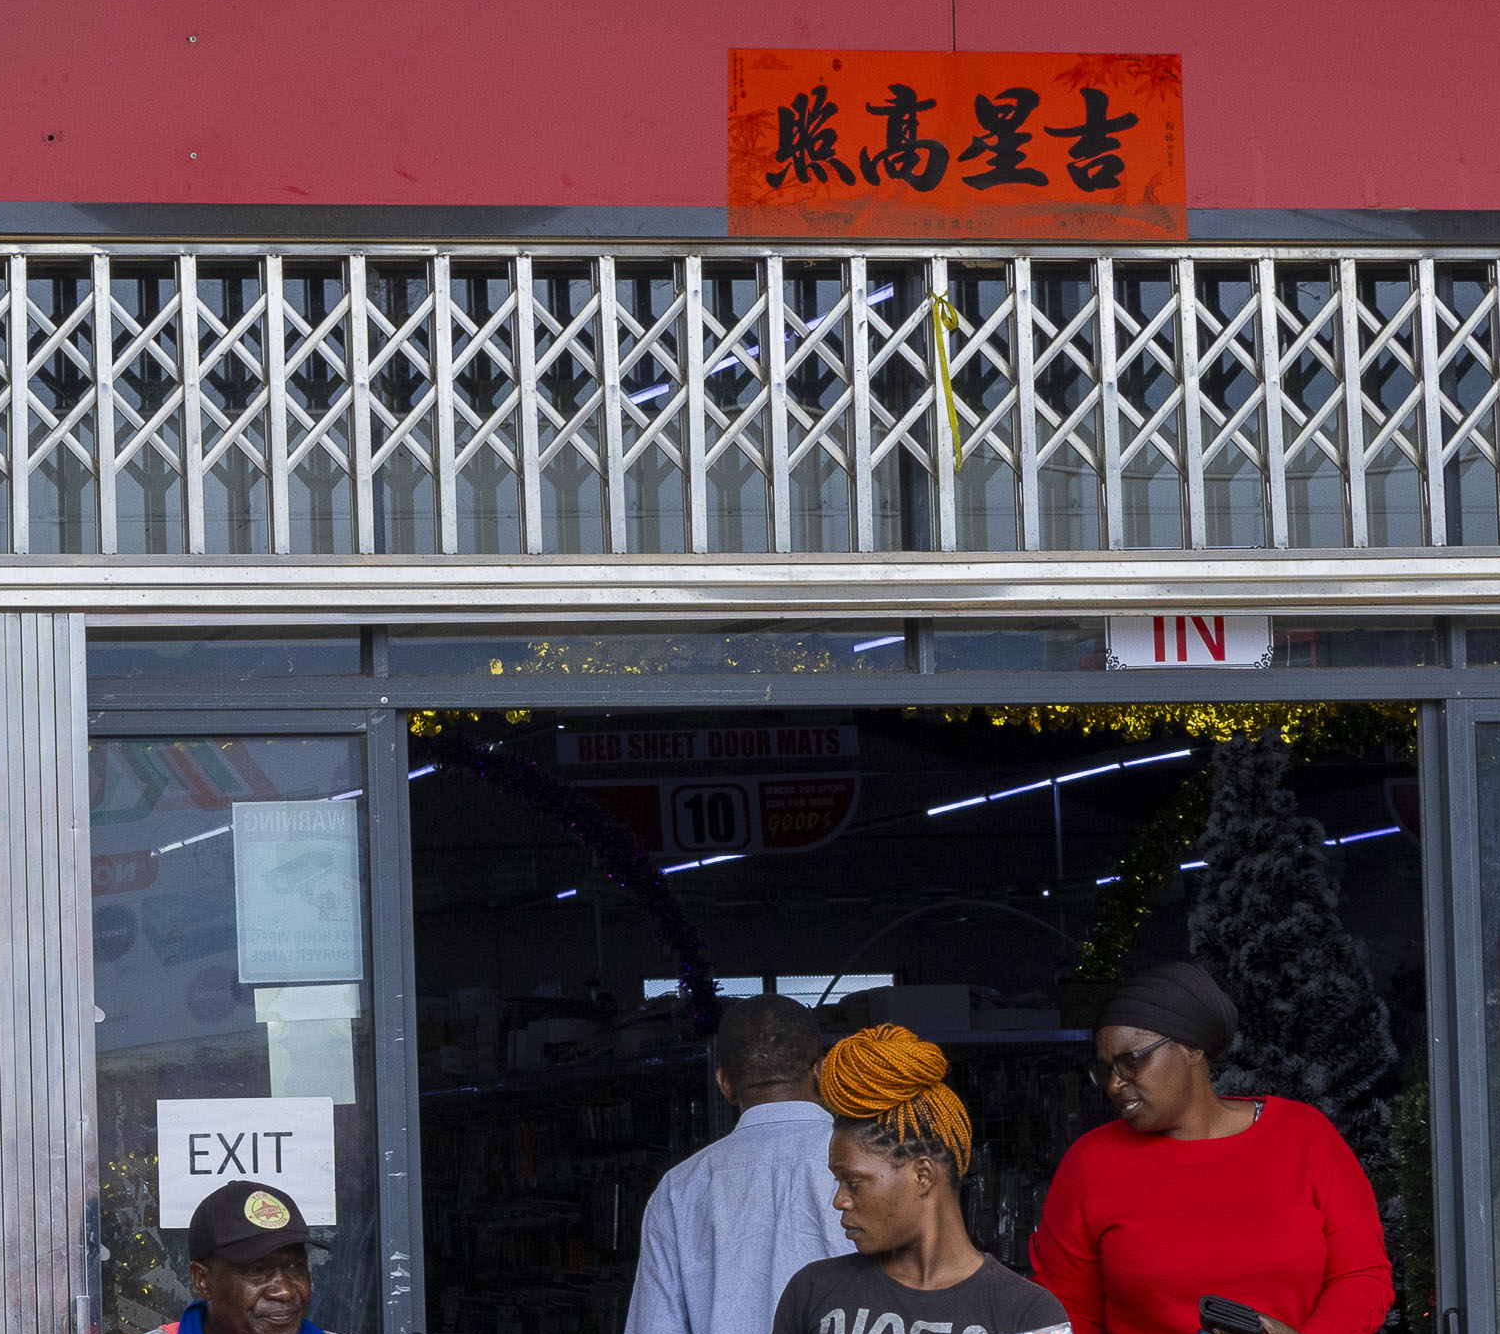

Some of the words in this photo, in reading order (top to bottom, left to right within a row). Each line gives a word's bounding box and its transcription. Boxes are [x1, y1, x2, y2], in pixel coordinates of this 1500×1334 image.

[1153, 615, 1226, 662] IN
[577, 733, 623, 761] BED
[628, 731, 697, 760] SHEET
[708, 729, 772, 758] DOOR
[777, 727, 841, 756] MATS
[684, 791, 736, 844] 10
[766, 810, 833, 838] GOODS
[188, 1131, 293, 1175] EXIT
